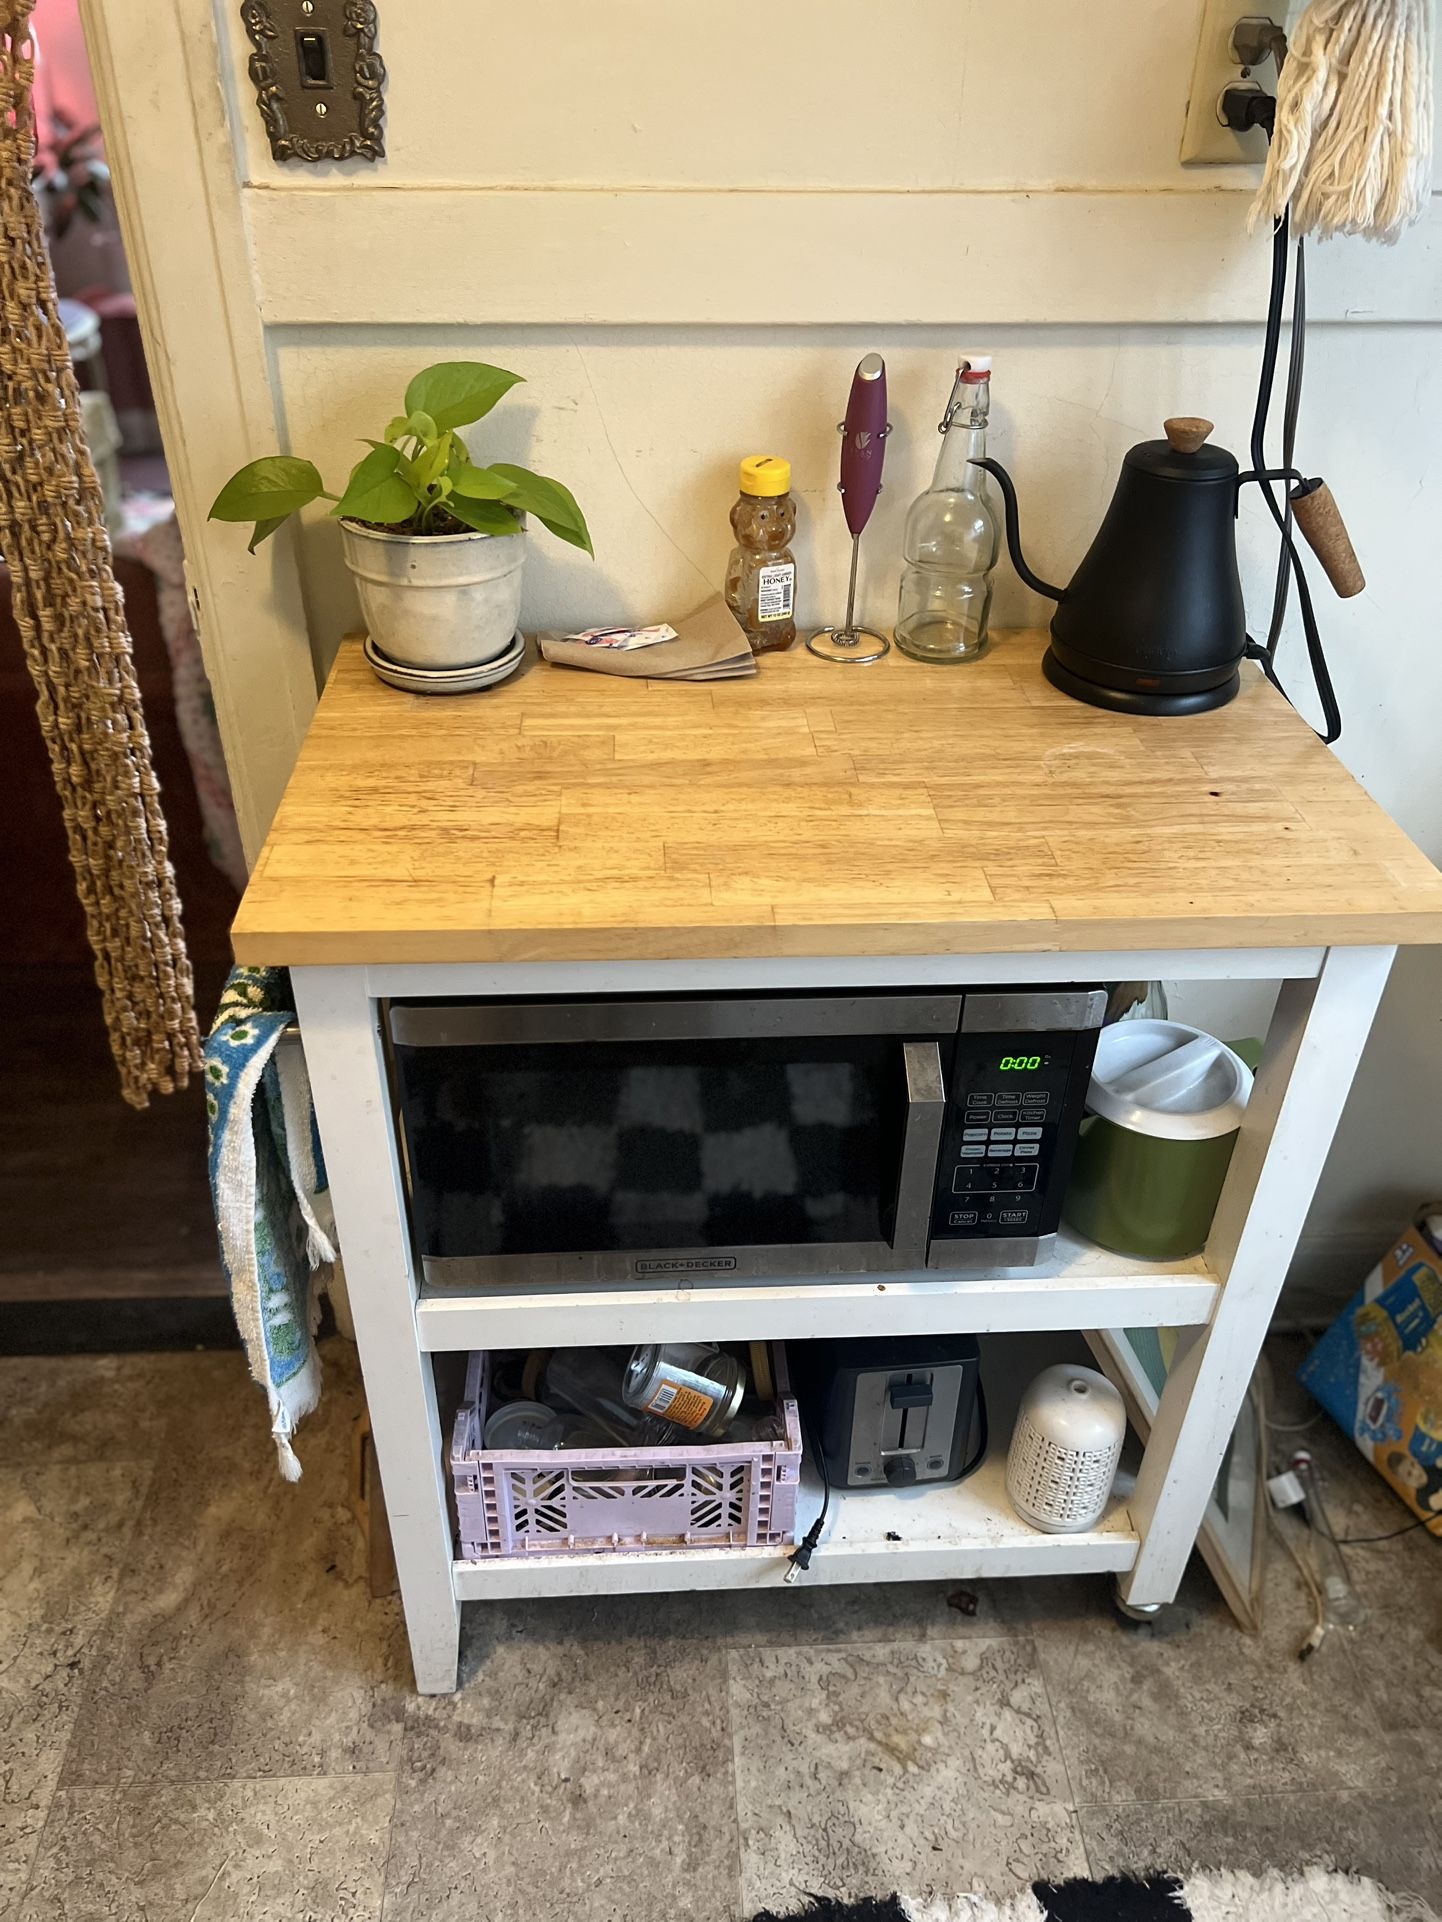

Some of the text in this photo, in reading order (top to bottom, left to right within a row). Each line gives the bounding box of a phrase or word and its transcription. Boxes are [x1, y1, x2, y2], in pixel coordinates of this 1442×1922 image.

[763, 576, 789, 585] HONEY
[999, 1056, 1041, 1070] 0:00
[640, 1260, 732, 1271] BLACK+DECKER
